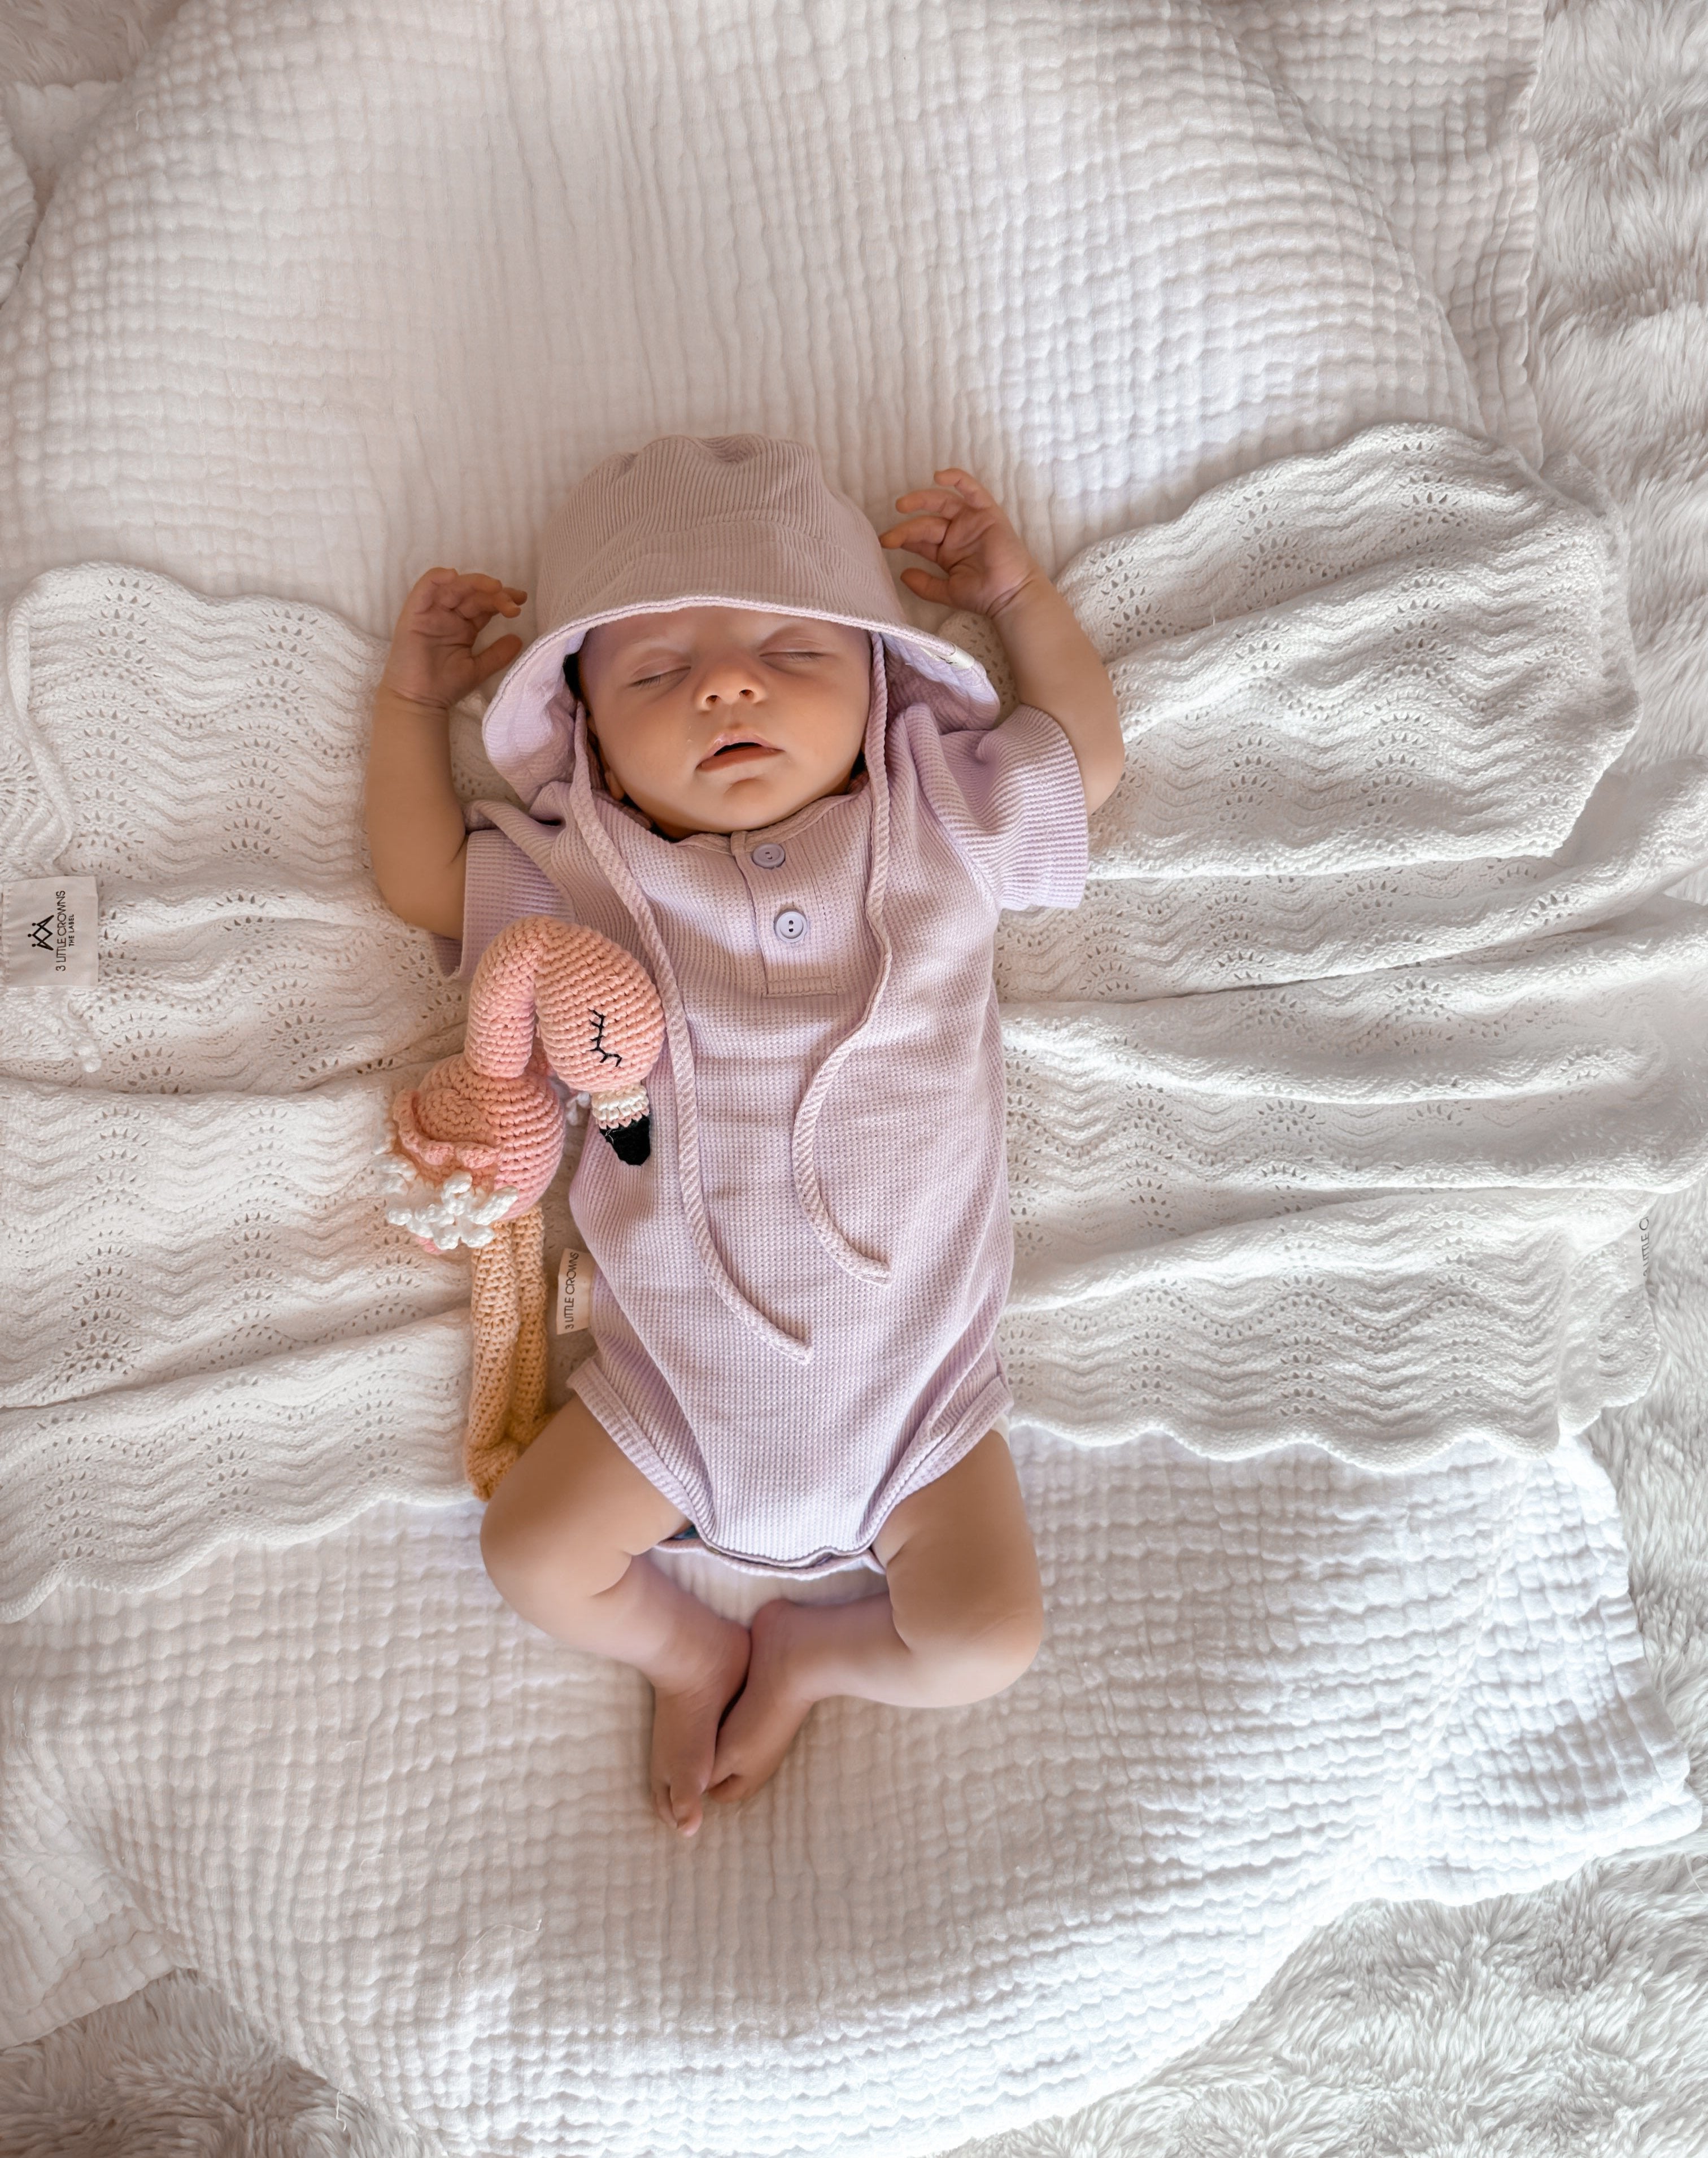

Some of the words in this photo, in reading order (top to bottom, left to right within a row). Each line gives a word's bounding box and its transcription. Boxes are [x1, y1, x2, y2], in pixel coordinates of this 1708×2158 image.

[56, 890, 67, 936] CROWNS
[56, 938, 67, 962] LITTLE
[565, 1252, 579, 1294] CROWNS
[564, 1297, 574, 1322] LITTLE
